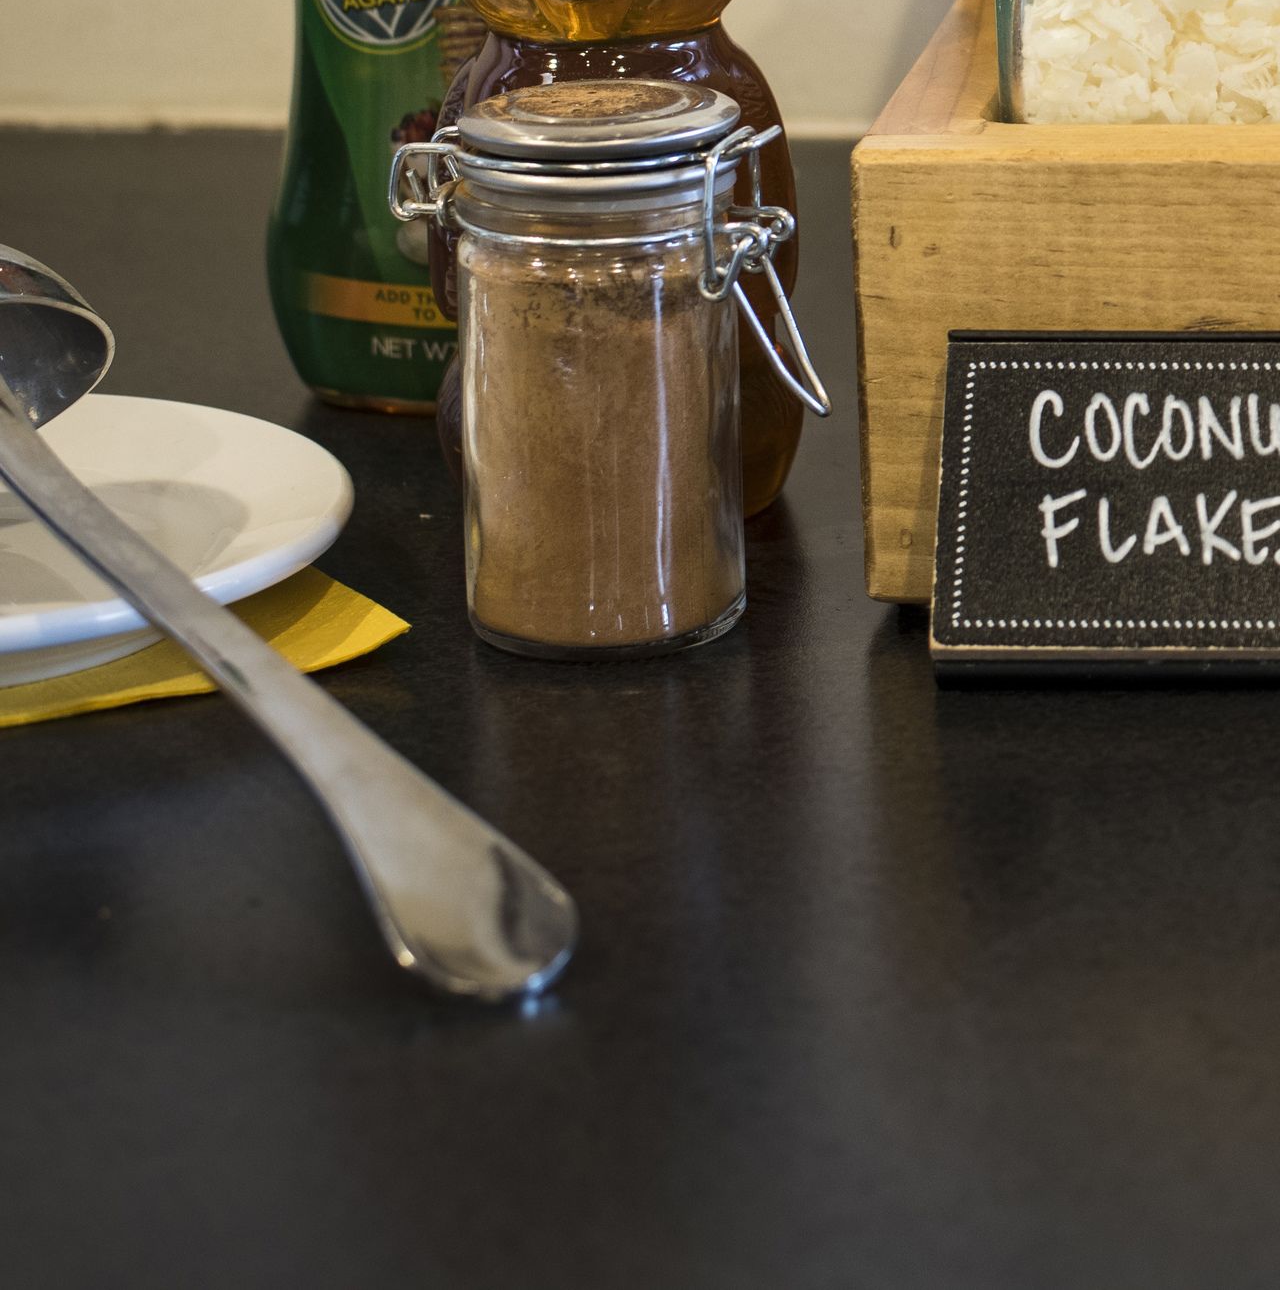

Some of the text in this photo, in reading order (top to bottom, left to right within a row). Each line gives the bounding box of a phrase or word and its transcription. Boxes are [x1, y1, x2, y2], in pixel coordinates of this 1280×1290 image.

[375, 289, 437, 306] ADD TH
[412, 307, 437, 322] TO
[371, 336, 417, 359] NET
